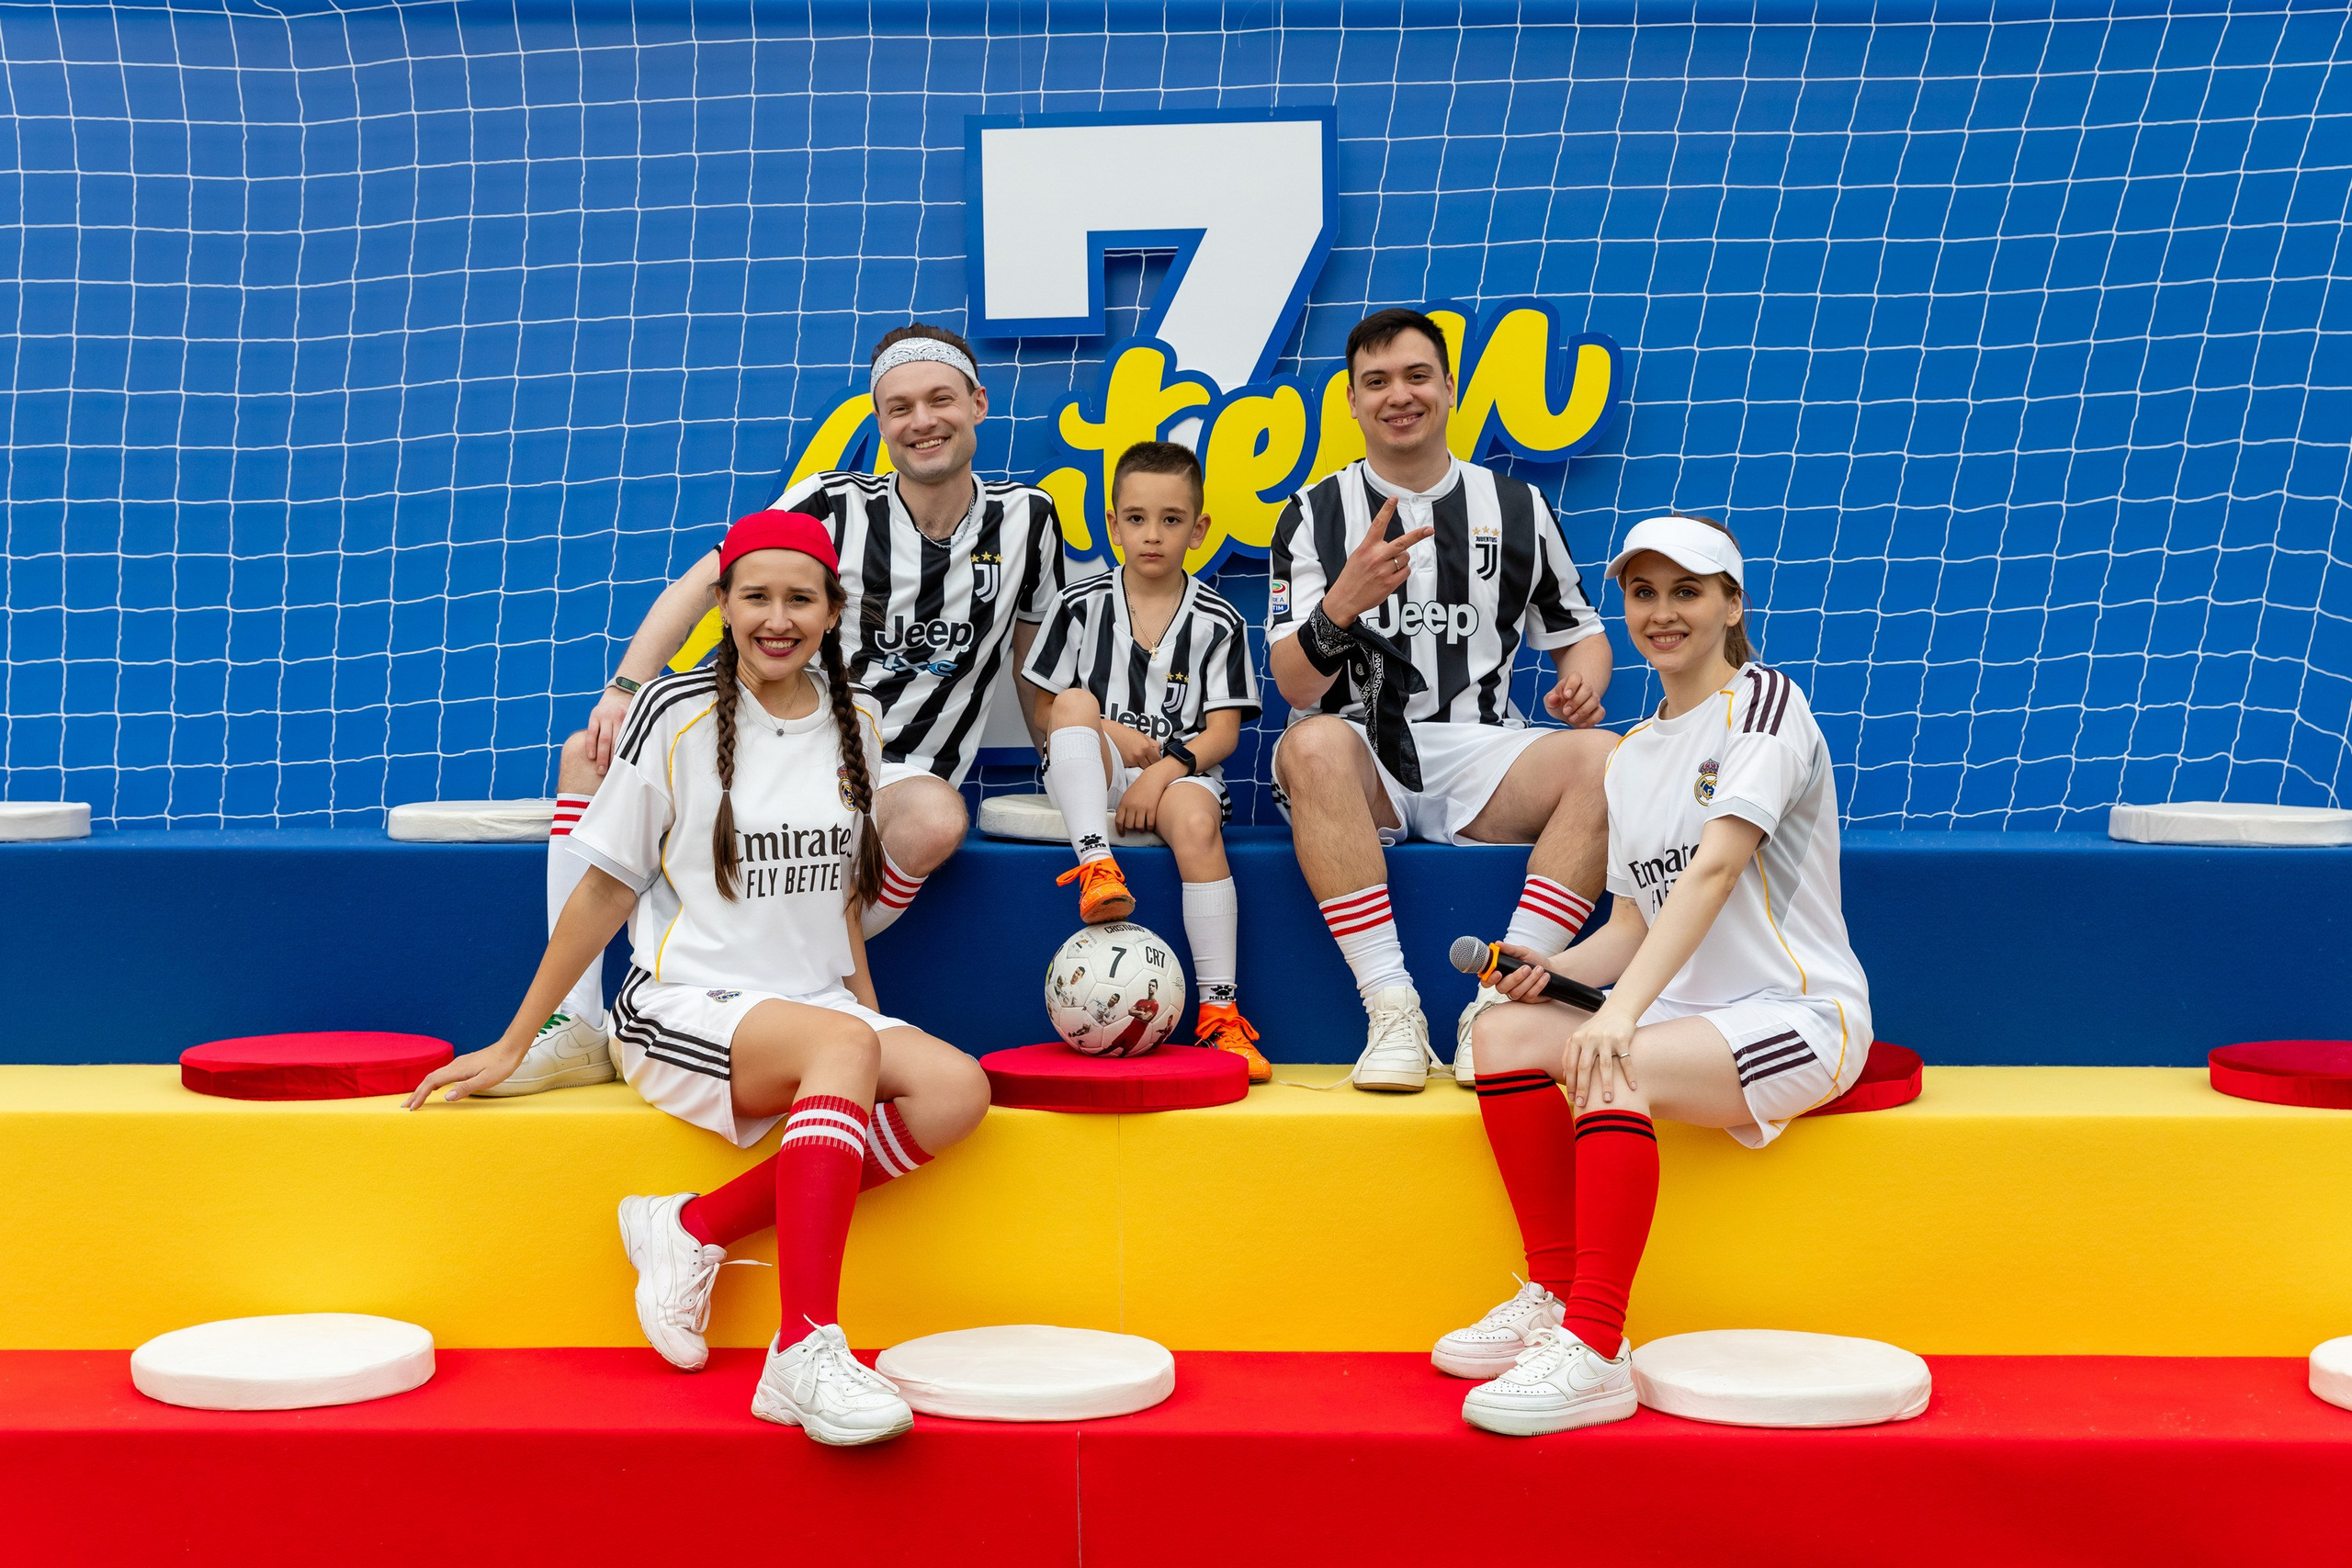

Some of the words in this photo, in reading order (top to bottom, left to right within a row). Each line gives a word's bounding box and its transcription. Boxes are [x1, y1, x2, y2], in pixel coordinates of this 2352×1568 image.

[875, 615, 974, 651] Jeep
[1366, 592, 1479, 645] Jeep
[734, 822, 853, 863] mirate
[746, 868, 778, 898] FLY
[785, 862, 842, 895] BETTE
[1108, 946, 1127, 978] 7
[1145, 945, 1166, 969] CR7
